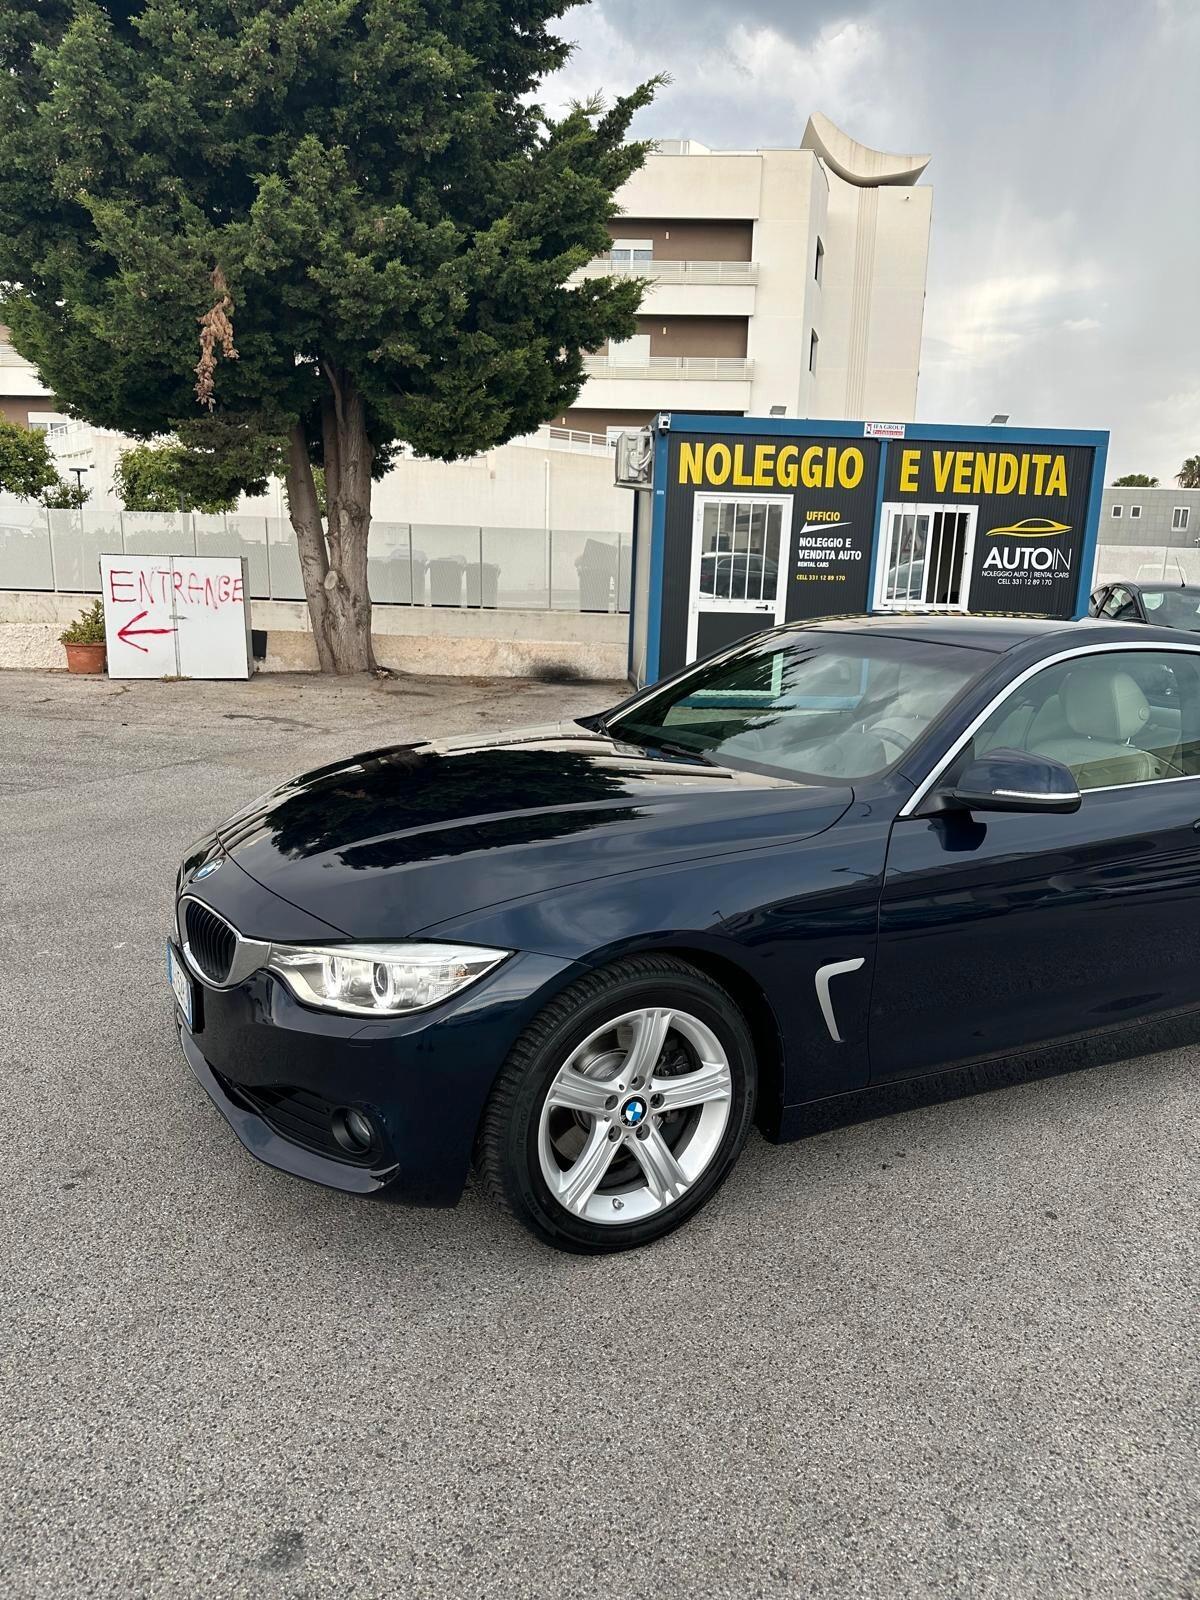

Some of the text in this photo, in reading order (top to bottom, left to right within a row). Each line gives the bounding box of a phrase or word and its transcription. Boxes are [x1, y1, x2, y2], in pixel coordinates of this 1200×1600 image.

[679, 442, 1068, 497] NOLEGGIO E VENDITA
[806, 511, 840, 521] UFFICIO
[799, 537, 852, 547] NOLEGGIO E
[798, 550, 862, 560] VENDITA AUTO
[982, 546, 1072, 570] AUTOIN
[981, 570, 1013, 578] NOLEGGIO
[1033, 571, 1053, 579] RENTAL
[1053, 571, 1070, 579] CARS
